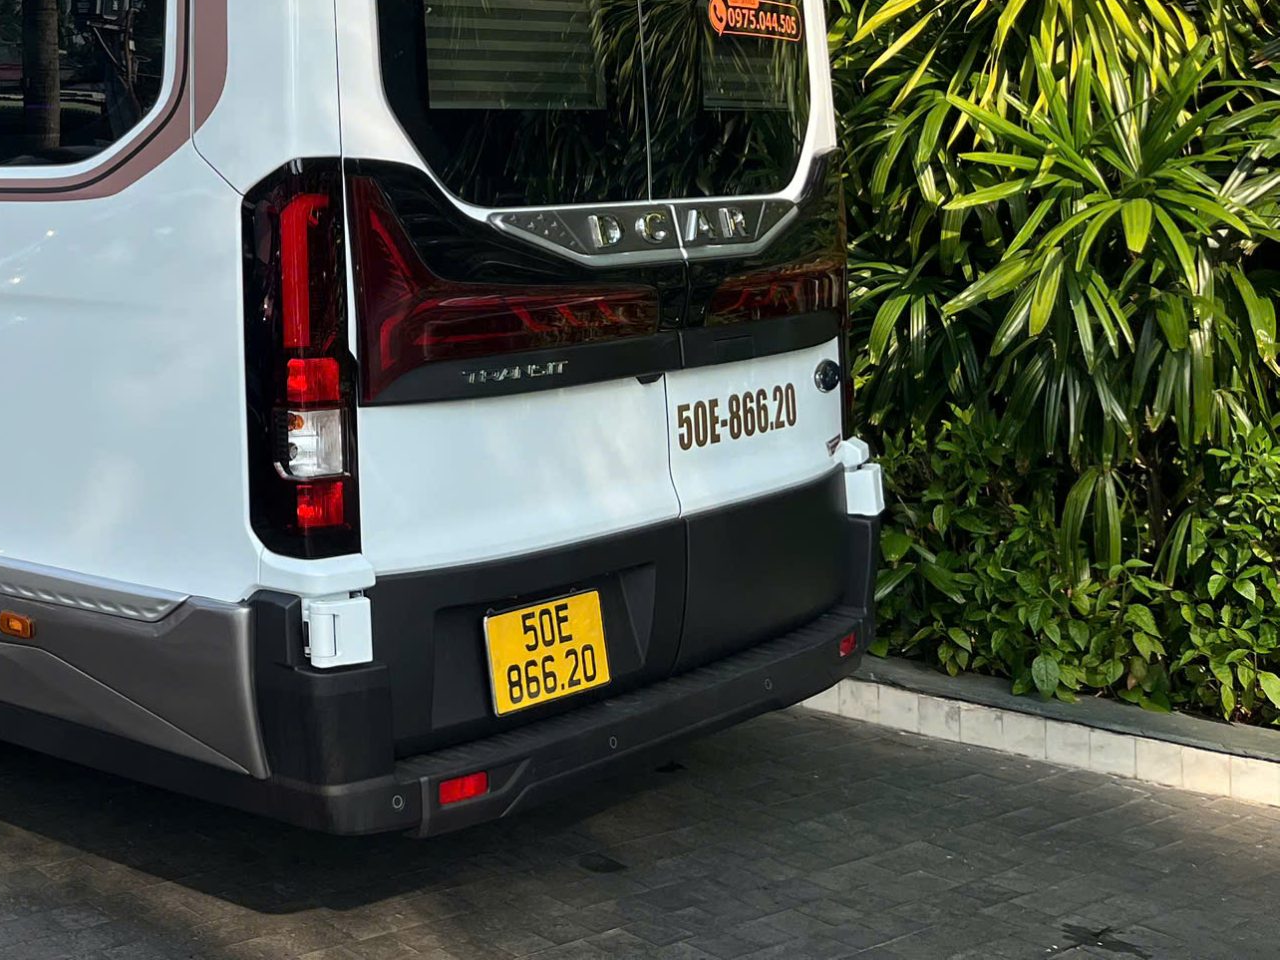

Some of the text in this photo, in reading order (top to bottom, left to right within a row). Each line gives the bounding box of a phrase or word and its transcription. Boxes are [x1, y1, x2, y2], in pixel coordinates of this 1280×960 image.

[727, 7, 797, 35] 0975.044.505
[588, 207, 750, 248] DCAR
[676, 382, 798, 451] 50E-866.20
[521, 603, 573, 652] 50E
[507, 643, 597, 705] 866.20
